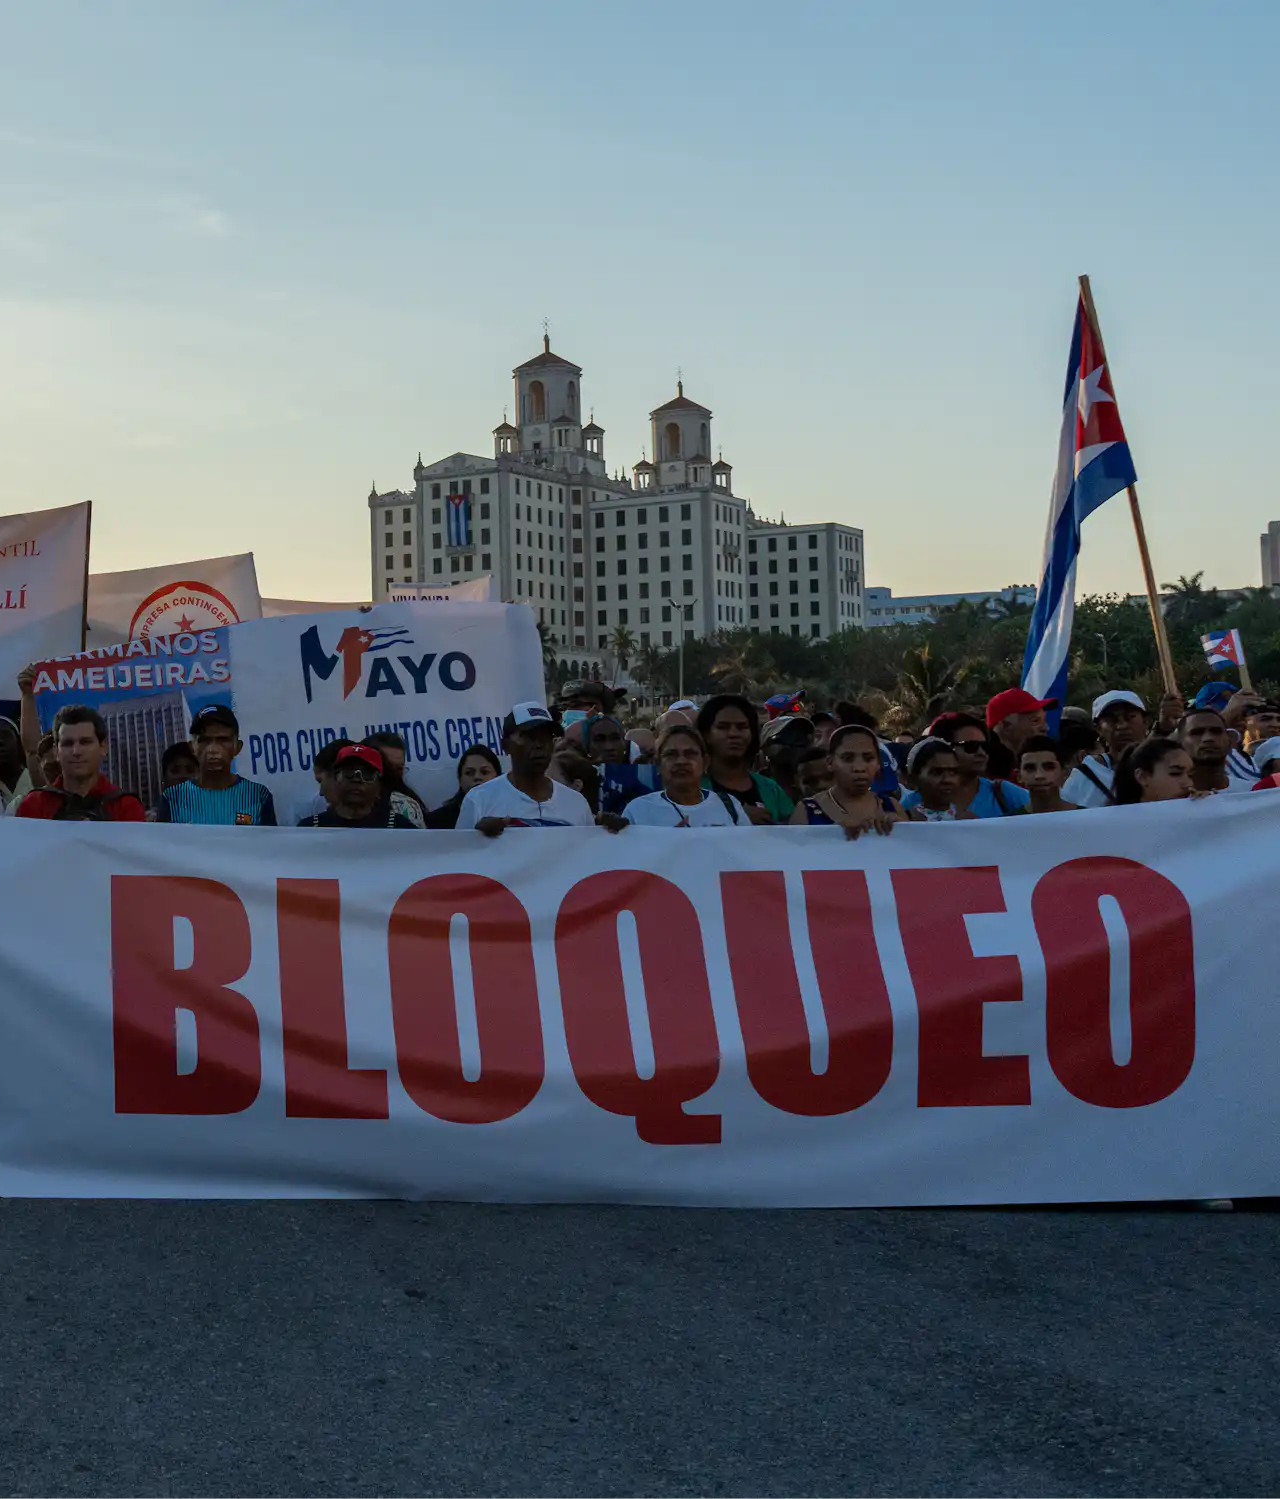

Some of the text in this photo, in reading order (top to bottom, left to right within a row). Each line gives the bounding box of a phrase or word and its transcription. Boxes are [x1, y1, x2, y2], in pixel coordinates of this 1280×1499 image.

[140, 596, 231, 641] MPRESA CONTINGEN
[33, 632, 220, 663] MANOS
[34, 659, 231, 694] AMEIJEIRAS
[249, 732, 293, 775] POR
[364, 719, 441, 763] TOS
[112, 869, 1195, 1145] BLOQUEO
